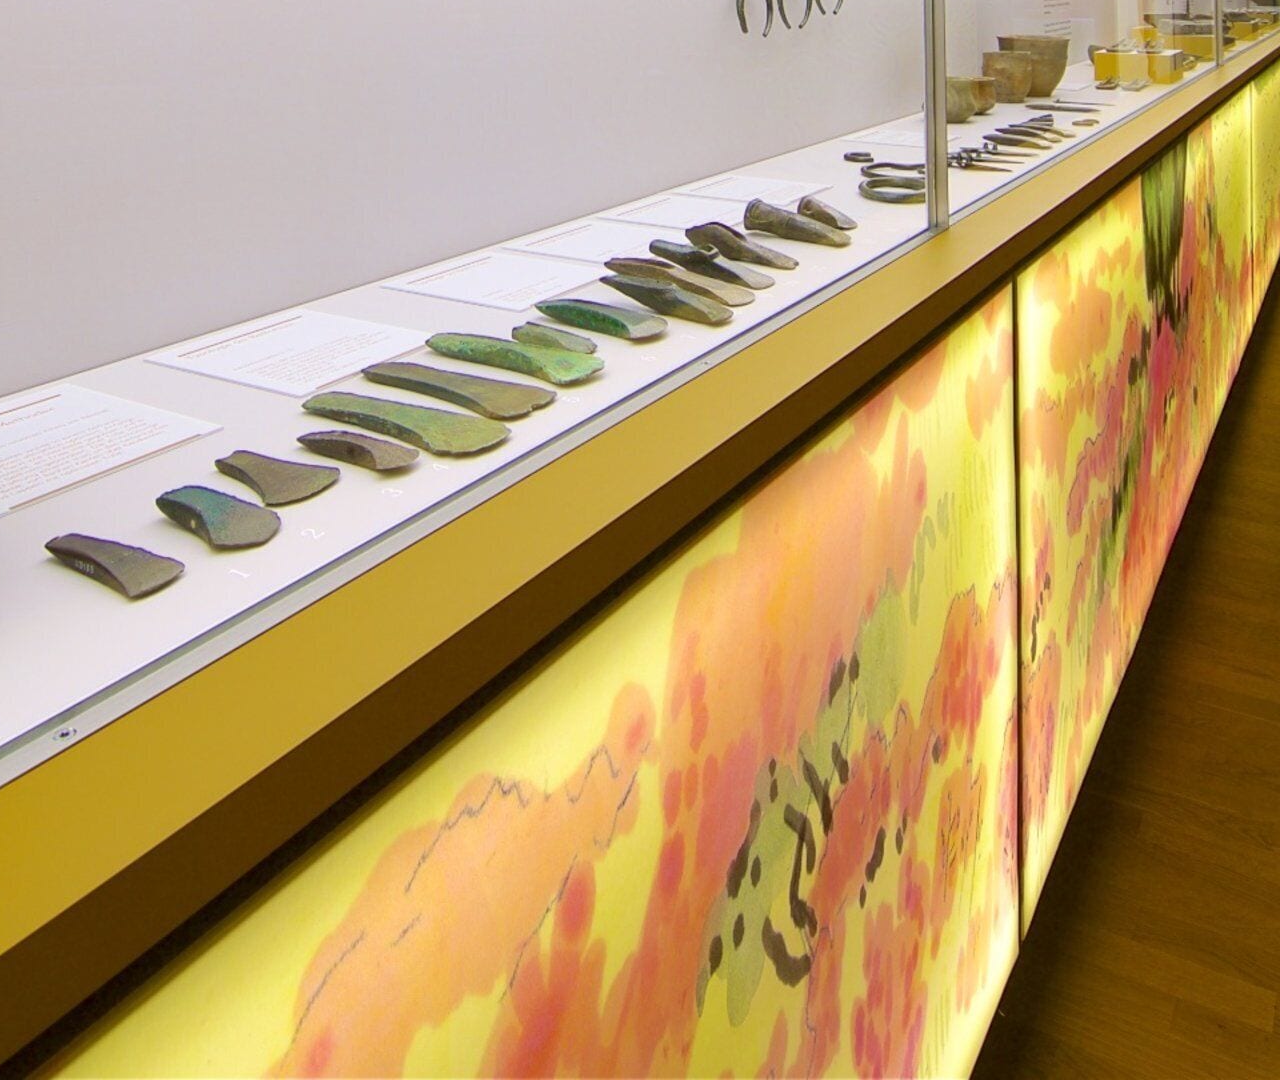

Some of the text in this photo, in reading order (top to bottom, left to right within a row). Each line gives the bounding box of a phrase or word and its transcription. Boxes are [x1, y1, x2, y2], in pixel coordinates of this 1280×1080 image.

[381, 487, 404, 498] 3
[300, 527, 326, 540] 2
[227, 569, 250, 578] 1
